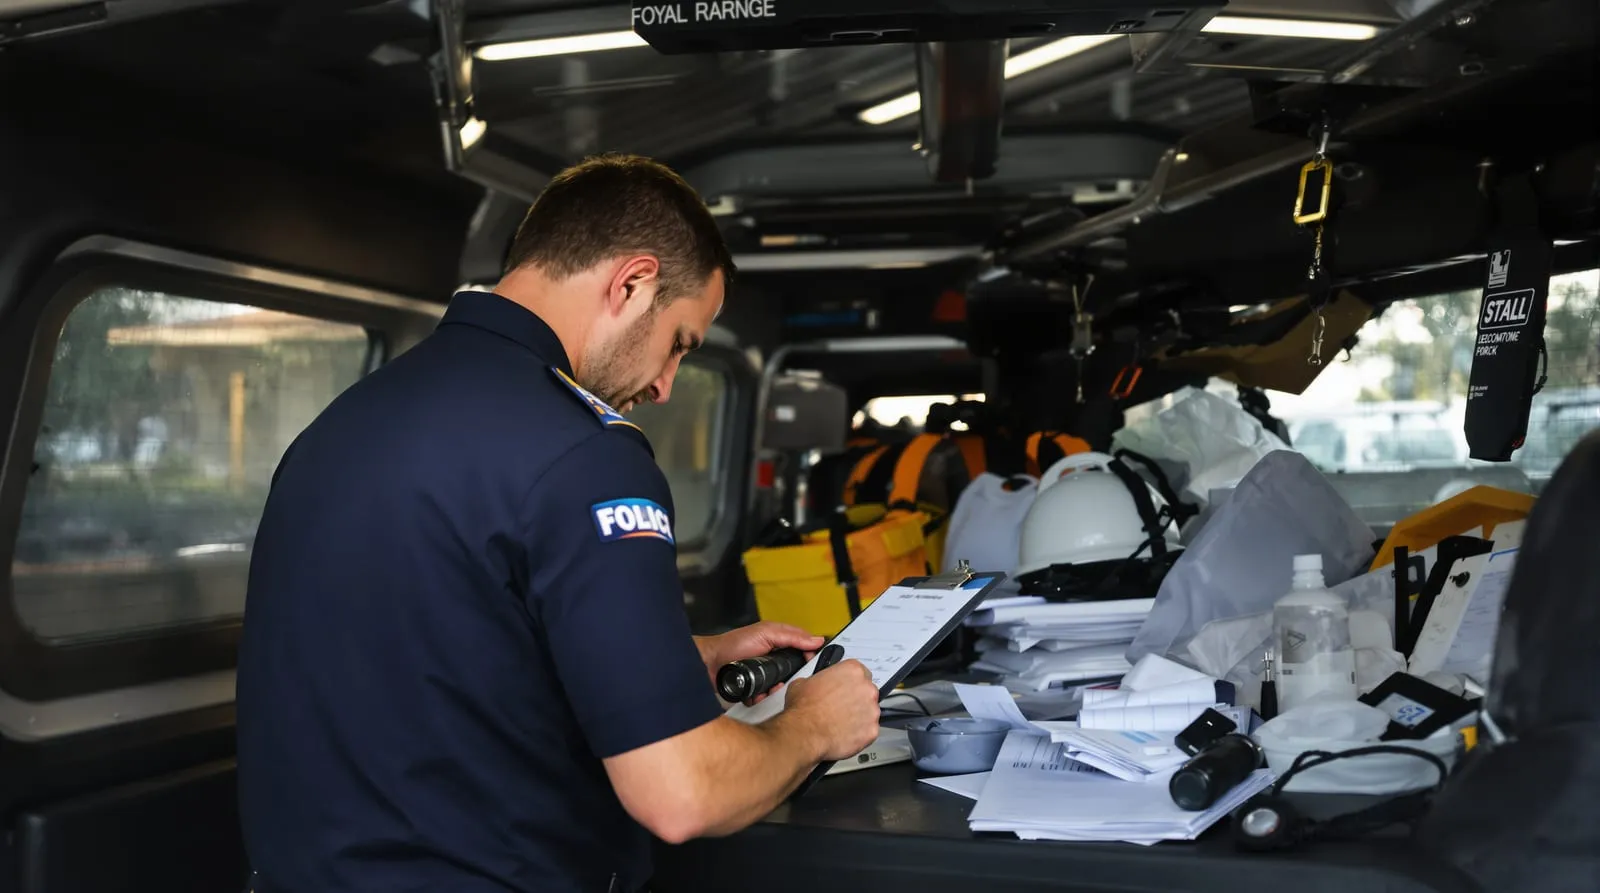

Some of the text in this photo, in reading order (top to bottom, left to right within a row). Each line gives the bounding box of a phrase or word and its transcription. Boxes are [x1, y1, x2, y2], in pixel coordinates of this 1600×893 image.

[631, 0, 776, 25] FOYAL RARNGE
[1484, 297, 1526, 323] STALL
